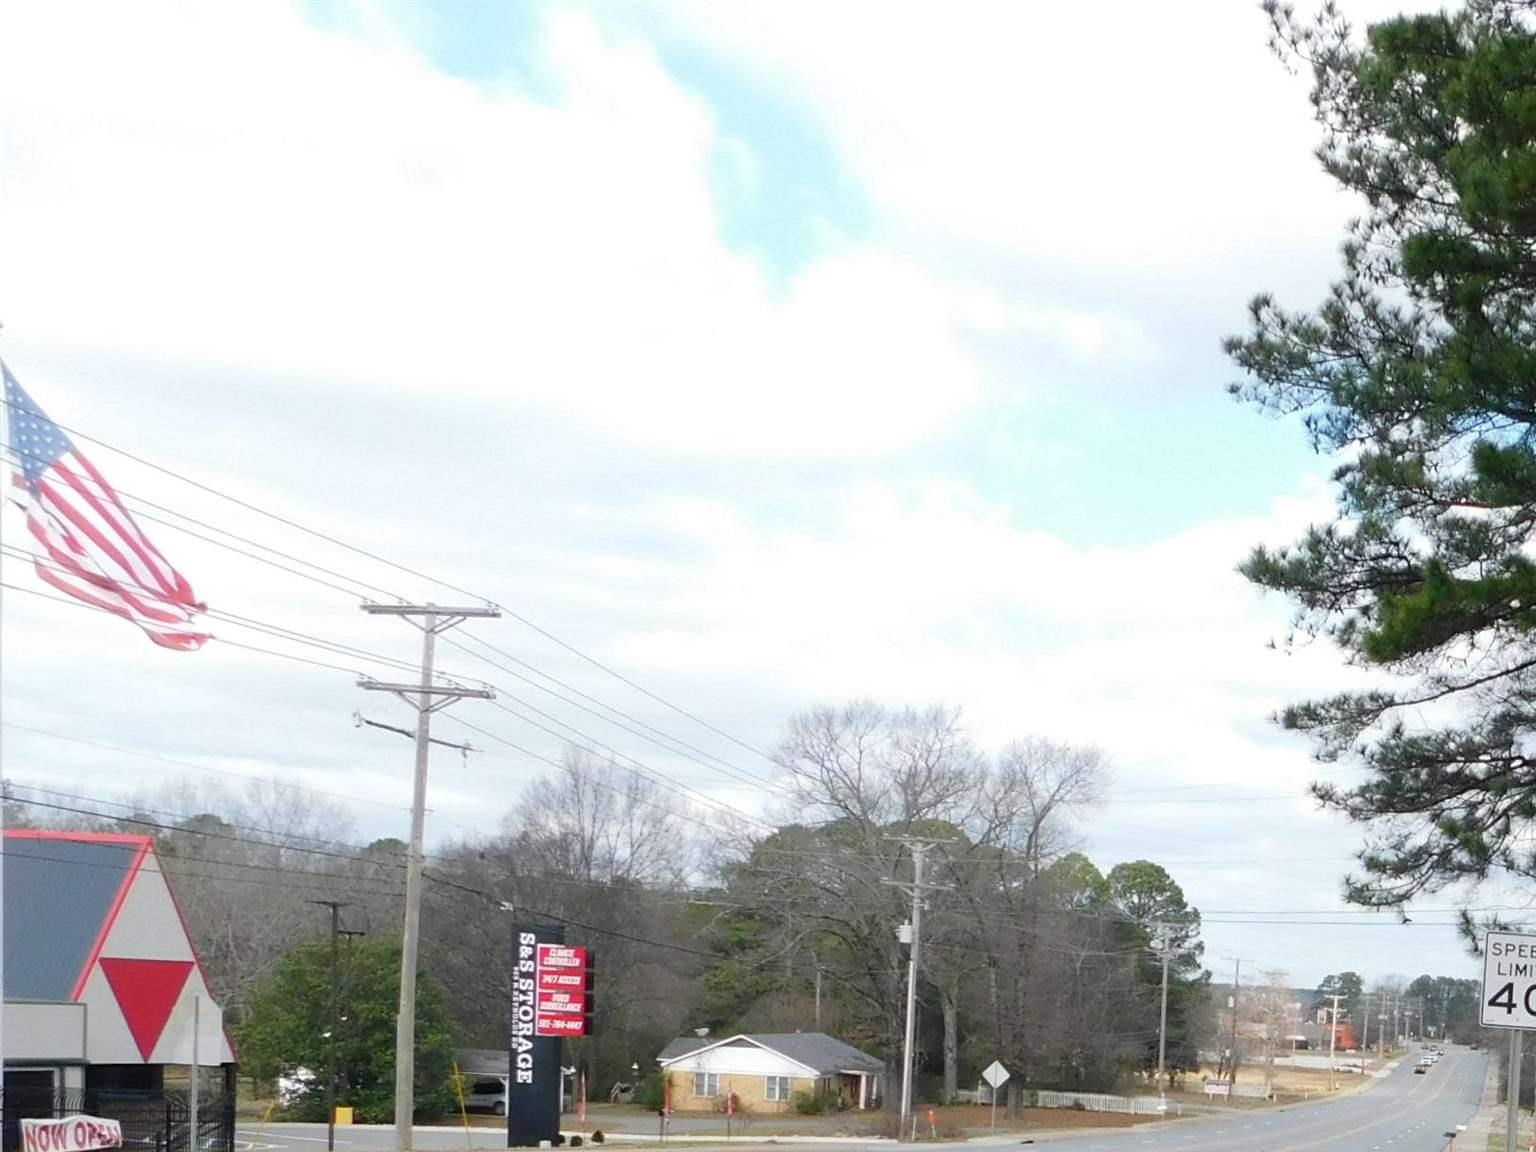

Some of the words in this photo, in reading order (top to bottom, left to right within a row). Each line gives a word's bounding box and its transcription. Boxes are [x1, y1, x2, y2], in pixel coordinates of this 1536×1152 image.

[519, 932, 536, 972] S&S
[517, 978, 534, 1084] STORAGE
[25, 1124, 67, 1152] NOW
[74, 1121, 121, 1149] OPEN
